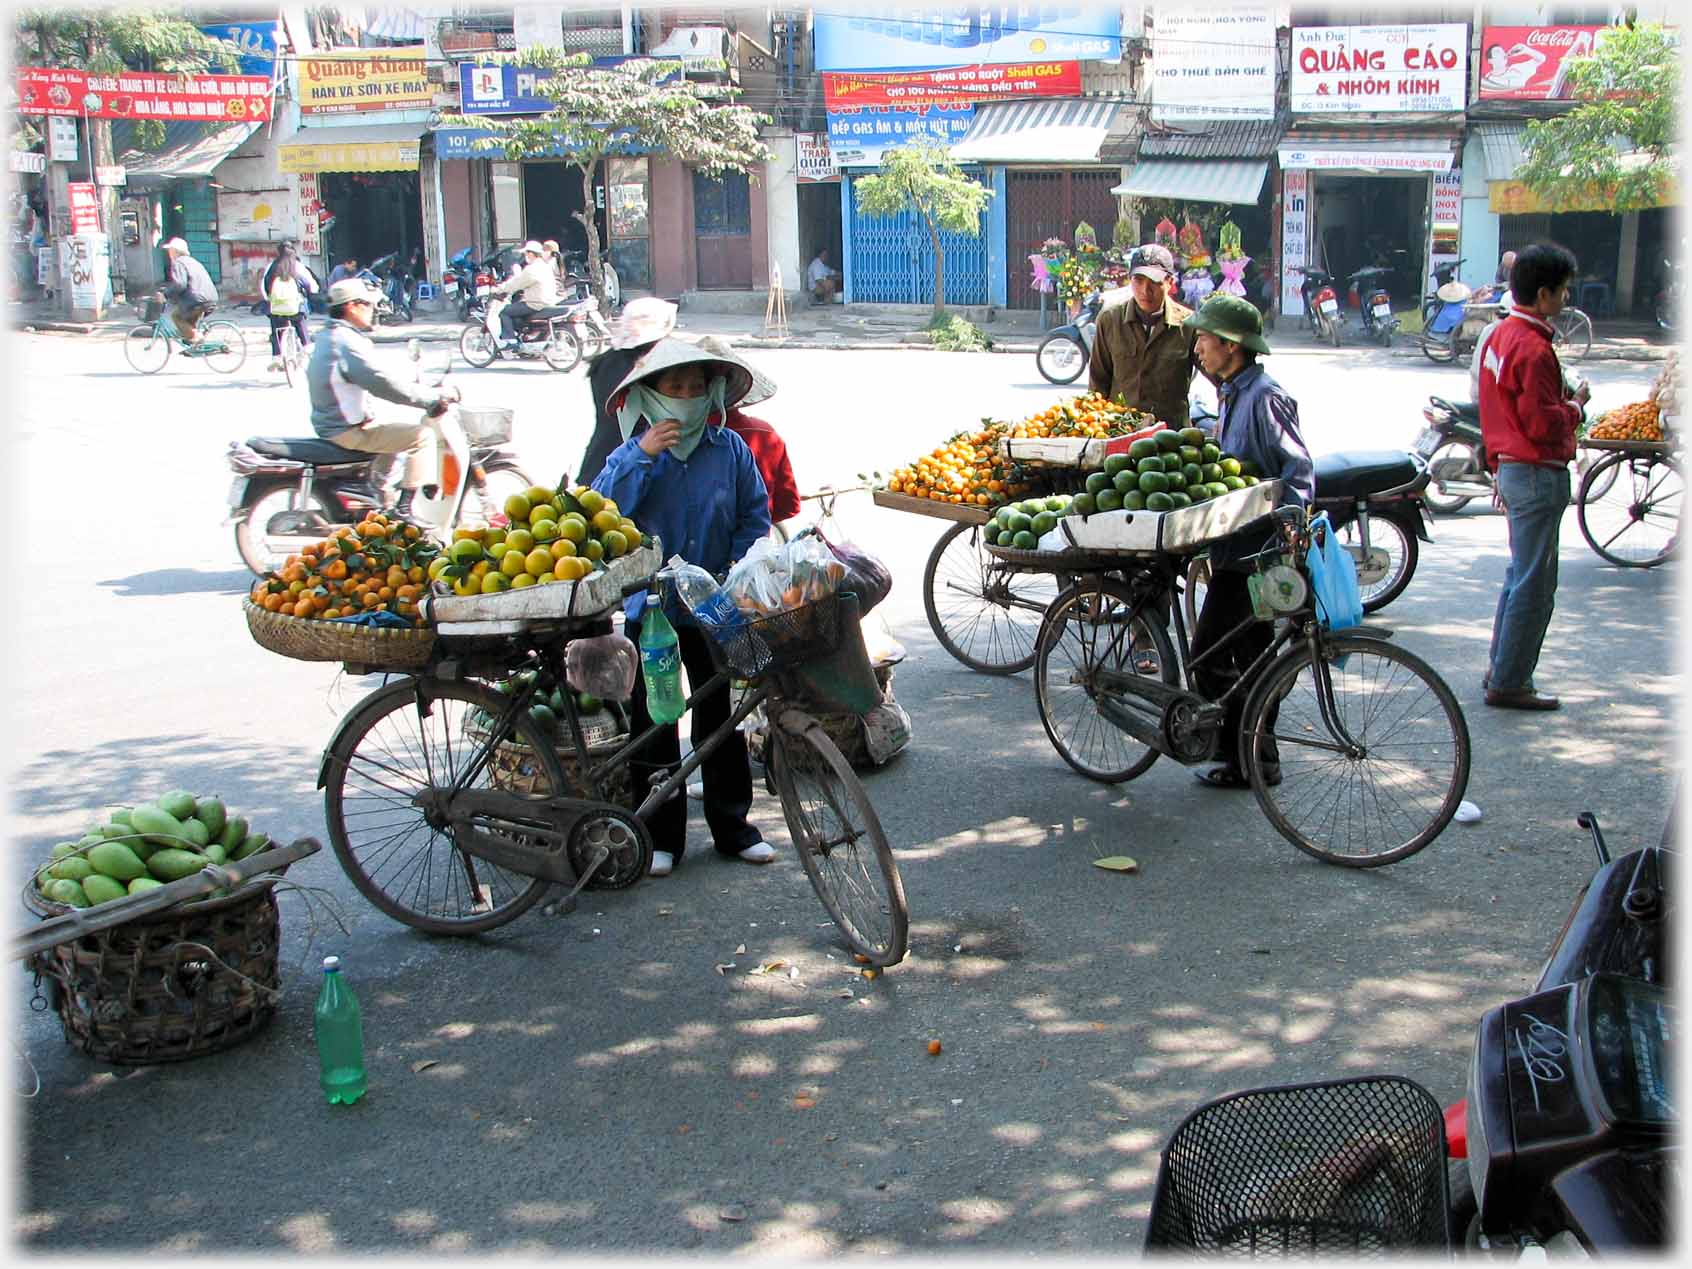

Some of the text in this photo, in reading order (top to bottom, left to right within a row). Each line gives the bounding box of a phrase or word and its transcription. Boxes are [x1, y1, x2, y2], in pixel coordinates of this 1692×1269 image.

[1299, 43, 1457, 74] QUẢNG CÁO
[959, 71, 976, 80] 100
[1006, 67, 1034, 79] Shell
[1035, 66, 1062, 77] GAS
[1155, 67, 1177, 77] CHO
[385, 82, 400, 95] XE
[1316, 74, 1440, 96] & NHÔM KÍNH
[886, 87, 906, 96] CHO
[908, 87, 925, 96] 100
[853, 121, 874, 134] GAS
[894, 121, 902, 133] &
[448, 136, 467, 147] 101
[1292, 194, 1304, 212] in
[1435, 201, 1457, 209] INOX
[1435, 212, 1457, 220] MICA
[305, 223, 316, 234] XE
